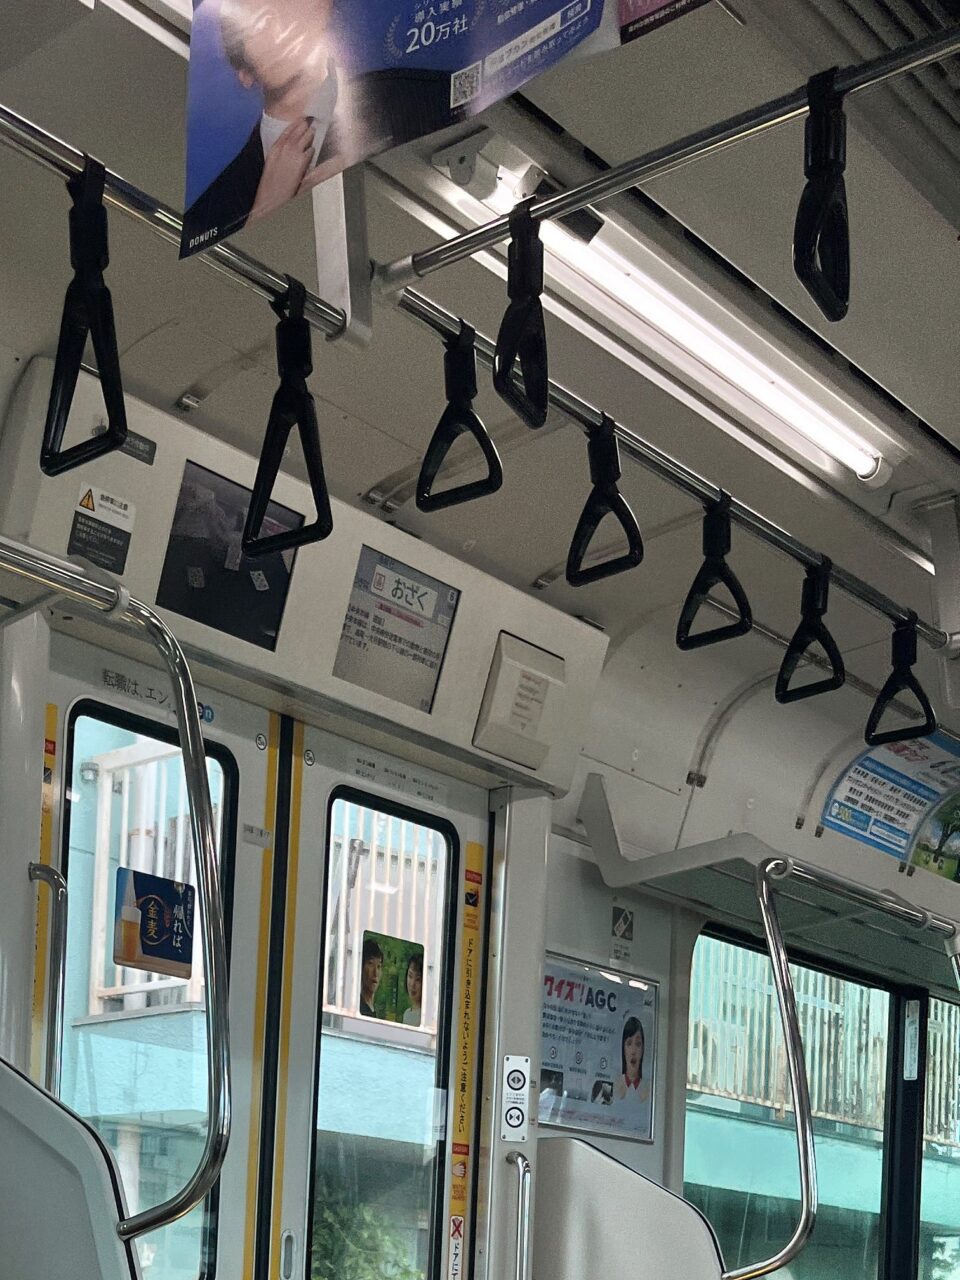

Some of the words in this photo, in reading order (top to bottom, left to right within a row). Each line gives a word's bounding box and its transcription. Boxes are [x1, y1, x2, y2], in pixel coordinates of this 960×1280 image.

[406, 14, 468, 53] 20万社
[190, 227, 218, 248] DONUTS
[391, 577, 429, 612] おざく
[146, 900, 159, 939] 金麦
